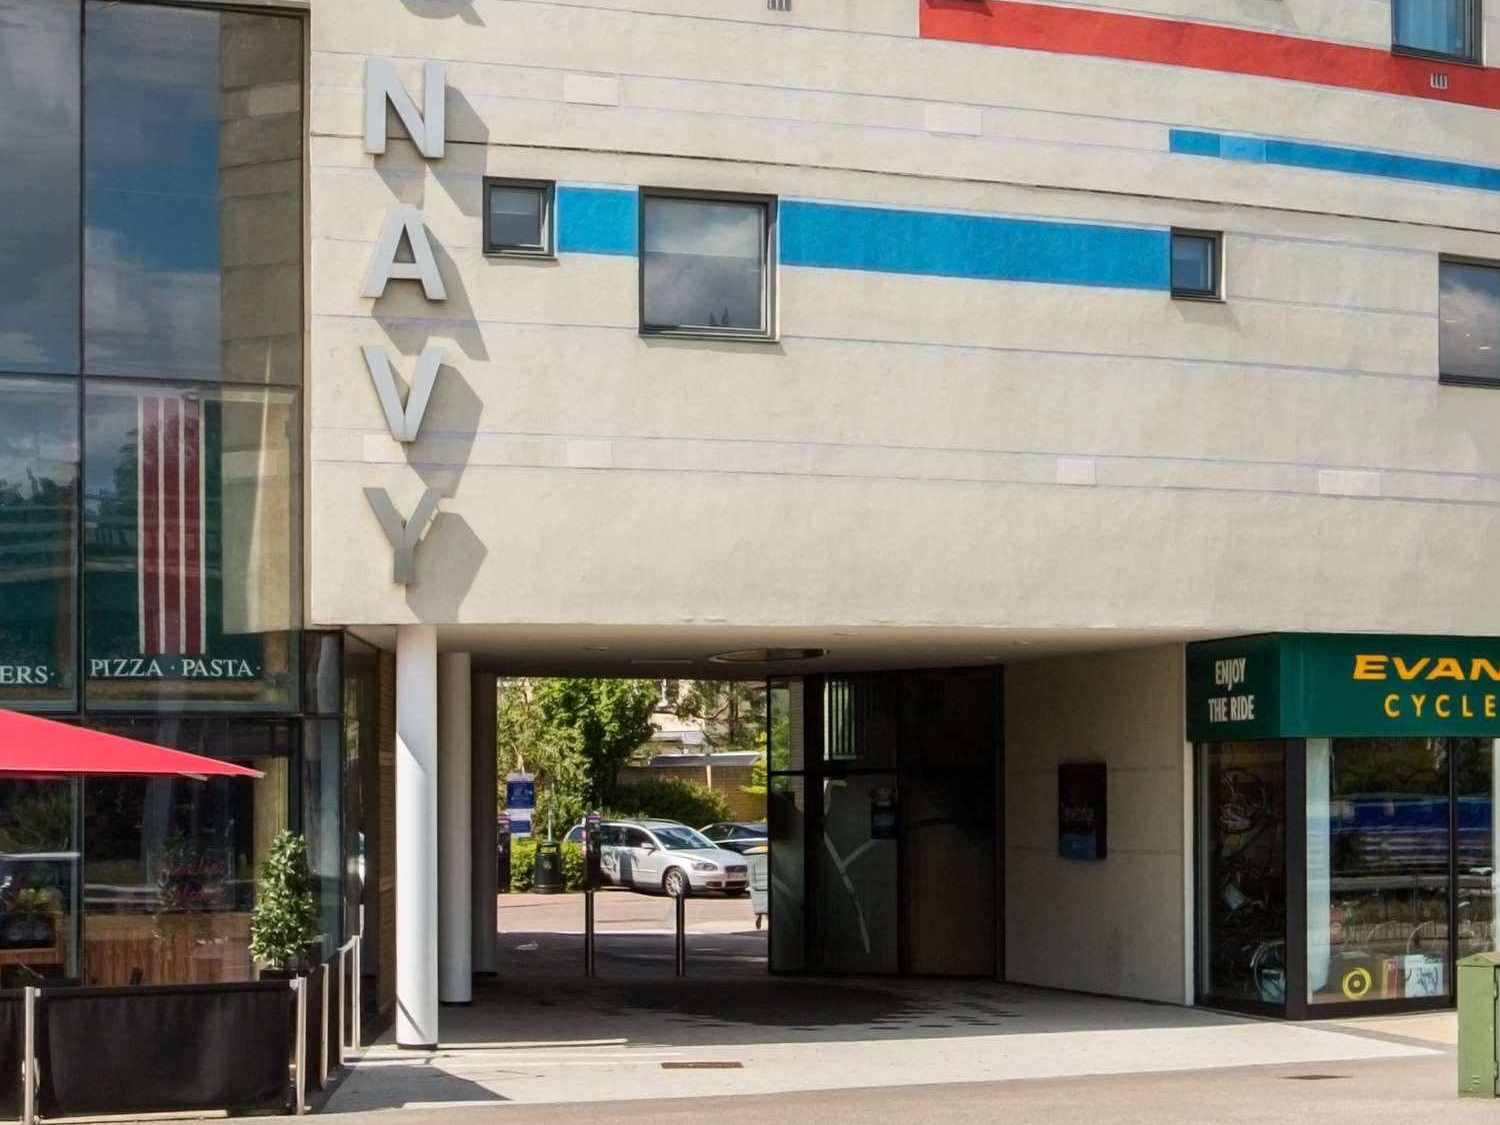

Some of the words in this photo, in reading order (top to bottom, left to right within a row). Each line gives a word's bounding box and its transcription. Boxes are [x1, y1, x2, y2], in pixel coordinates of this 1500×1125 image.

[360, 56, 449, 586] NAVY
[90, 658, 164, 678] PIZZA
[182, 658, 255, 678] PASTA
[1215, 657, 1247, 691] ENJOY
[1208, 697, 1228, 723] THE
[1230, 695, 1254, 721] RIDE
